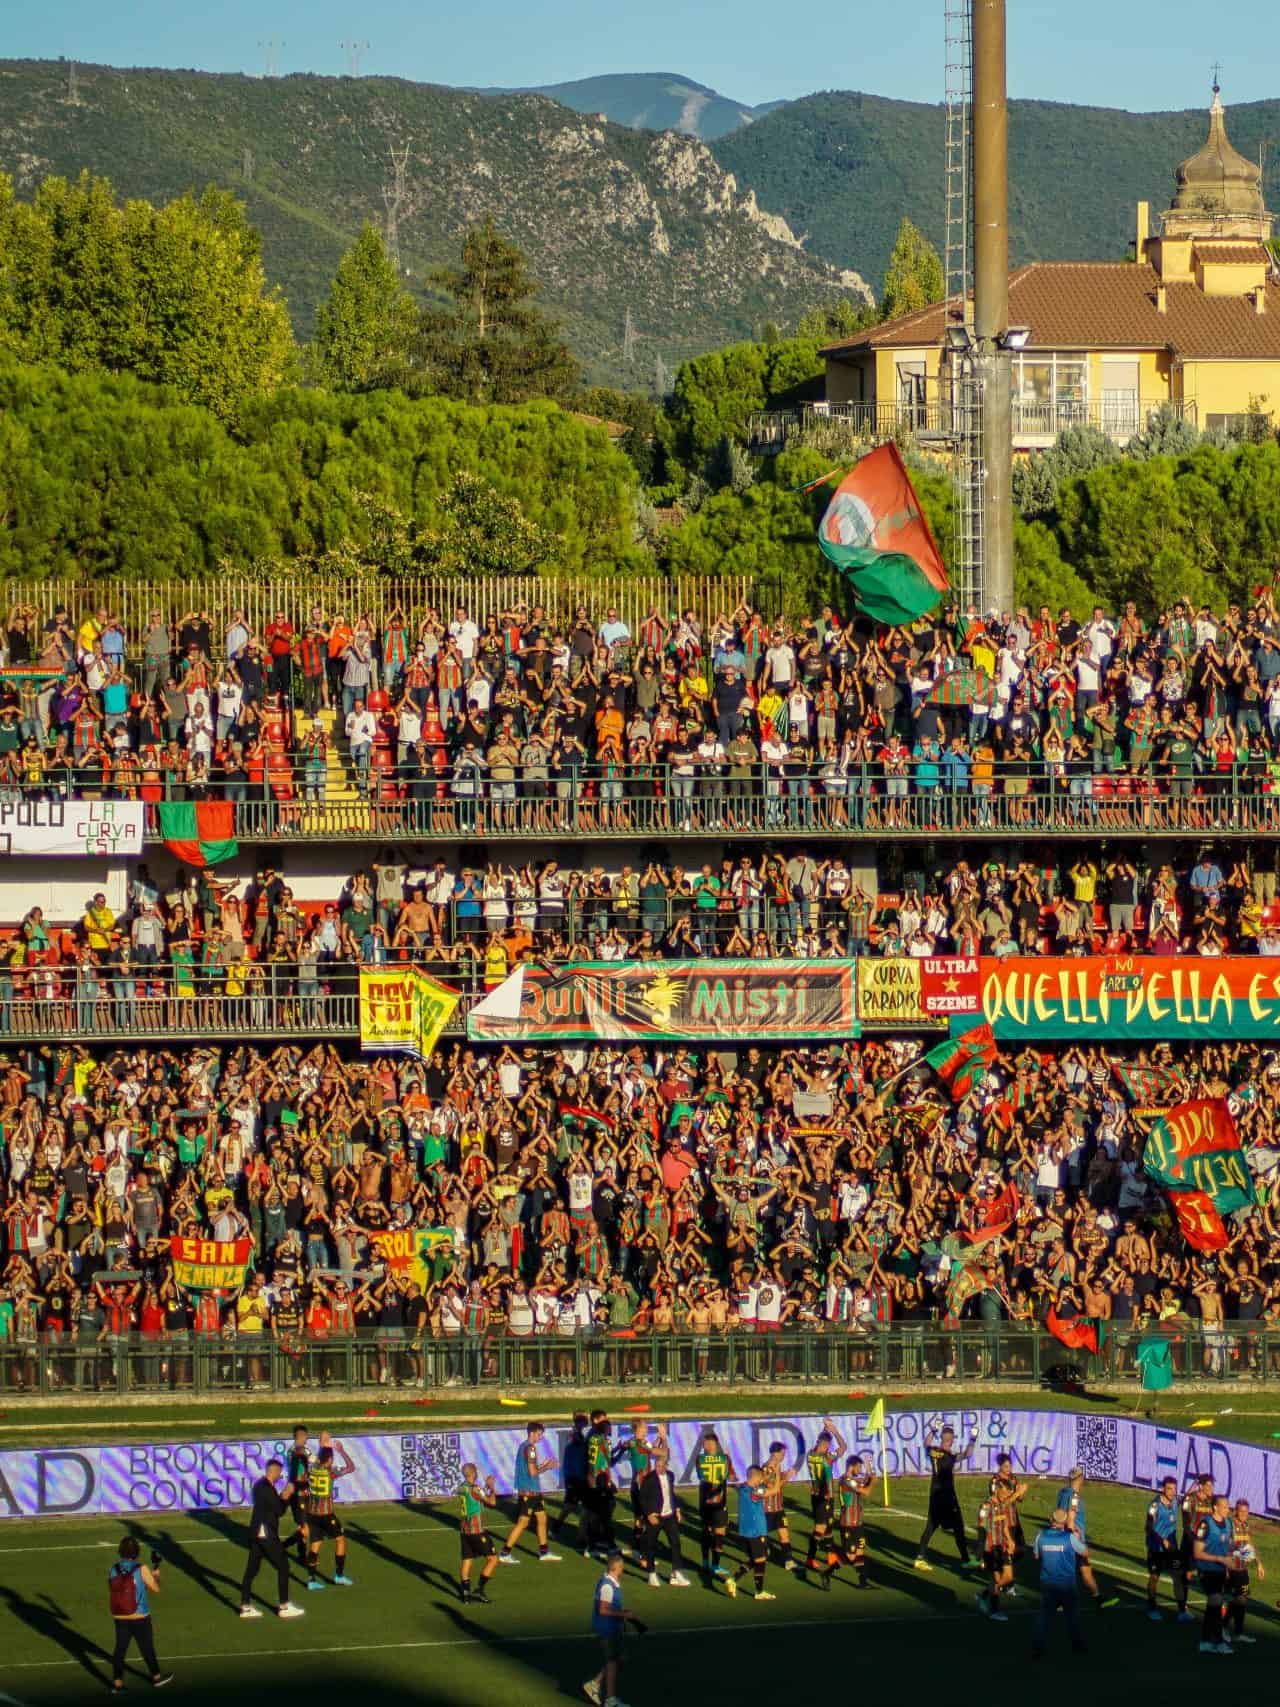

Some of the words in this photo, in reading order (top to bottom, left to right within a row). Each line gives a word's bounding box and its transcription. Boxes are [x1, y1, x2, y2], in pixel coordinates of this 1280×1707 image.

[90, 801, 114, 821] LA
[77, 822, 136, 838] CURVA
[86, 838, 120, 855] EST
[873, 966, 914, 985] CURVA
[924, 959, 978, 974] ULTRA
[691, 980, 807, 1019] Misti
[927, 995, 977, 1011] SZENE
[983, 970, 1109, 1025] QUELLI
[1125, 969, 1233, 1025] DELLA
[182, 1239, 236, 1263] SAN
[988, 1411, 1008, 1438] &
[131, 1442, 263, 1475] BROKER
